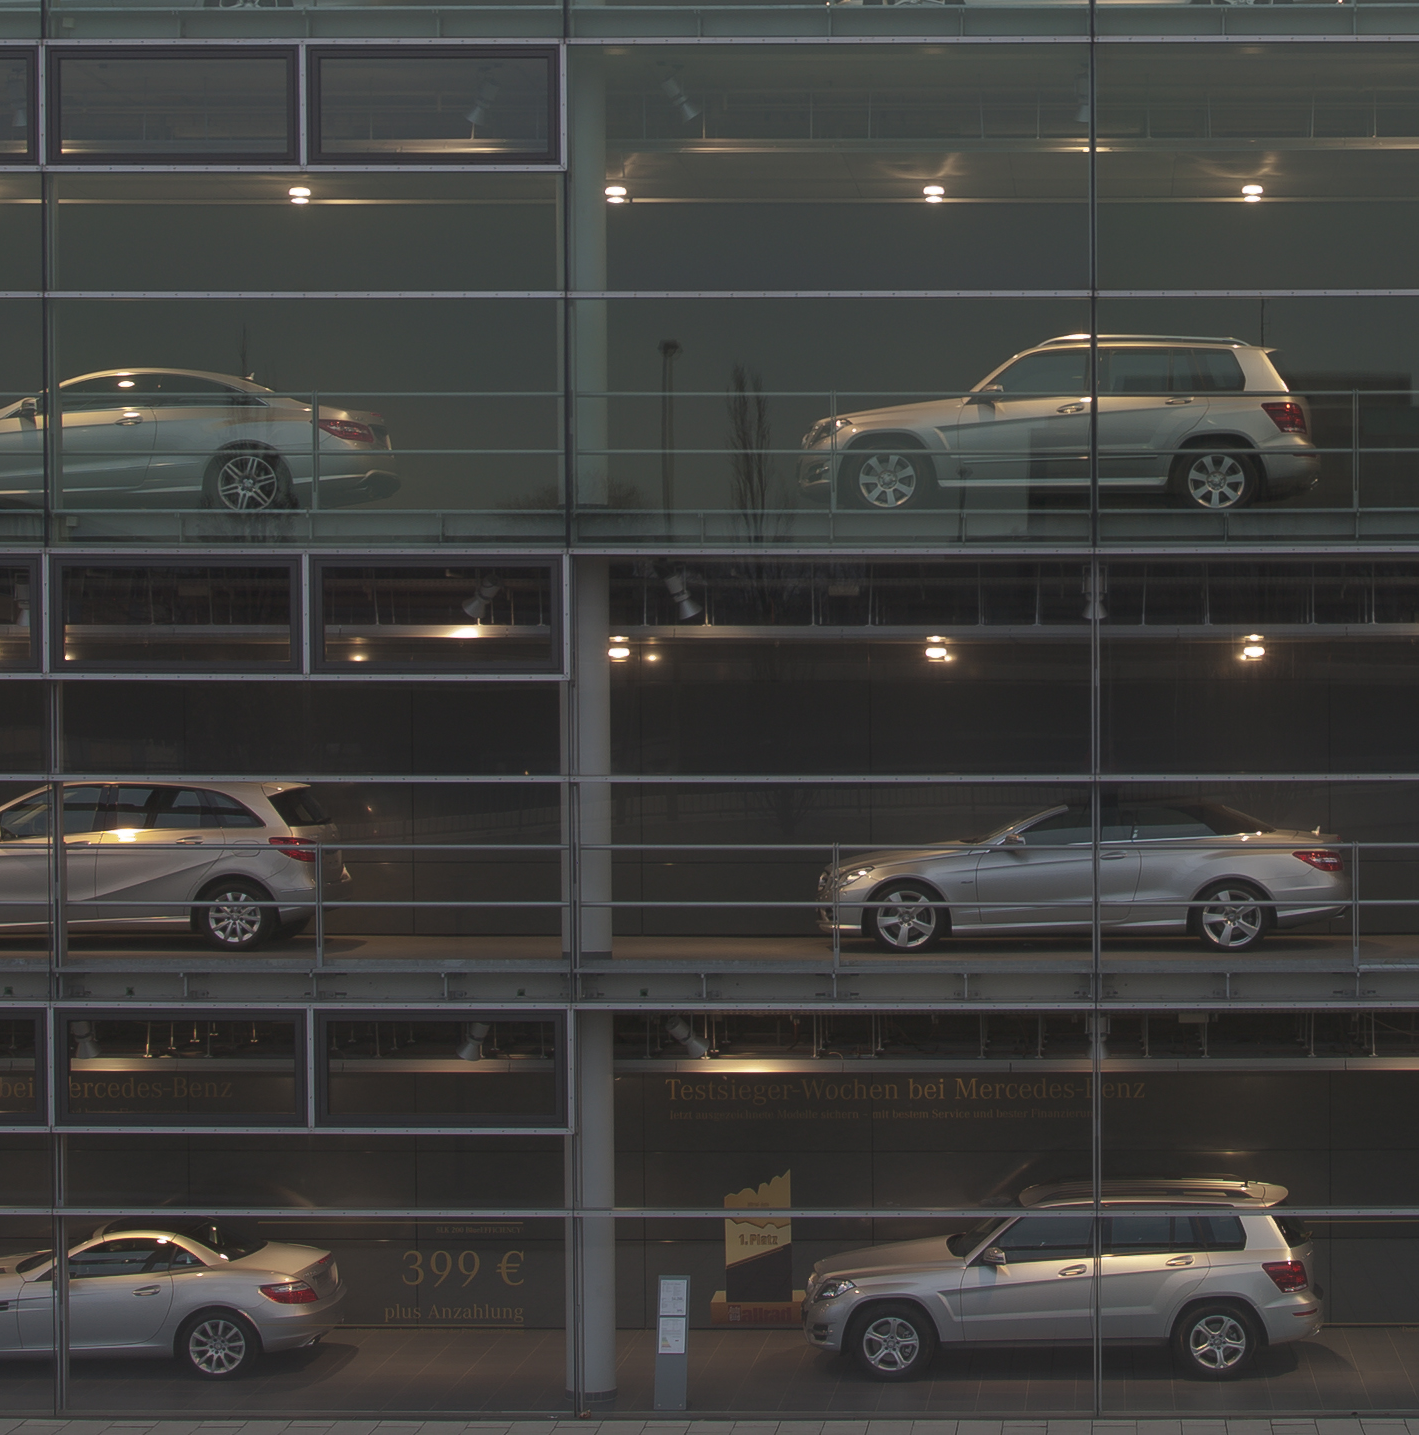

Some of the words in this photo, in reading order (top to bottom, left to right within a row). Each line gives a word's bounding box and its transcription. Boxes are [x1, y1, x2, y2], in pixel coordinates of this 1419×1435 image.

[69, 1077, 232, 1099] ercedes-Benz
[665, 1077, 899, 1105] Testsieger-Wochen
[908, 1077, 945, 1100] bei
[931, 1108, 971, 1119] Service
[973, 1109, 993, 1119] und
[749, 1233, 778, 1246] Platz
[401, 1250, 480, 1288] 399
[495, 1250, 525, 1286] €
[384, 1304, 422, 1323] plus
[428, 1304, 524, 1323] Anzahlung
[741, 1307, 792, 1323] allrad
